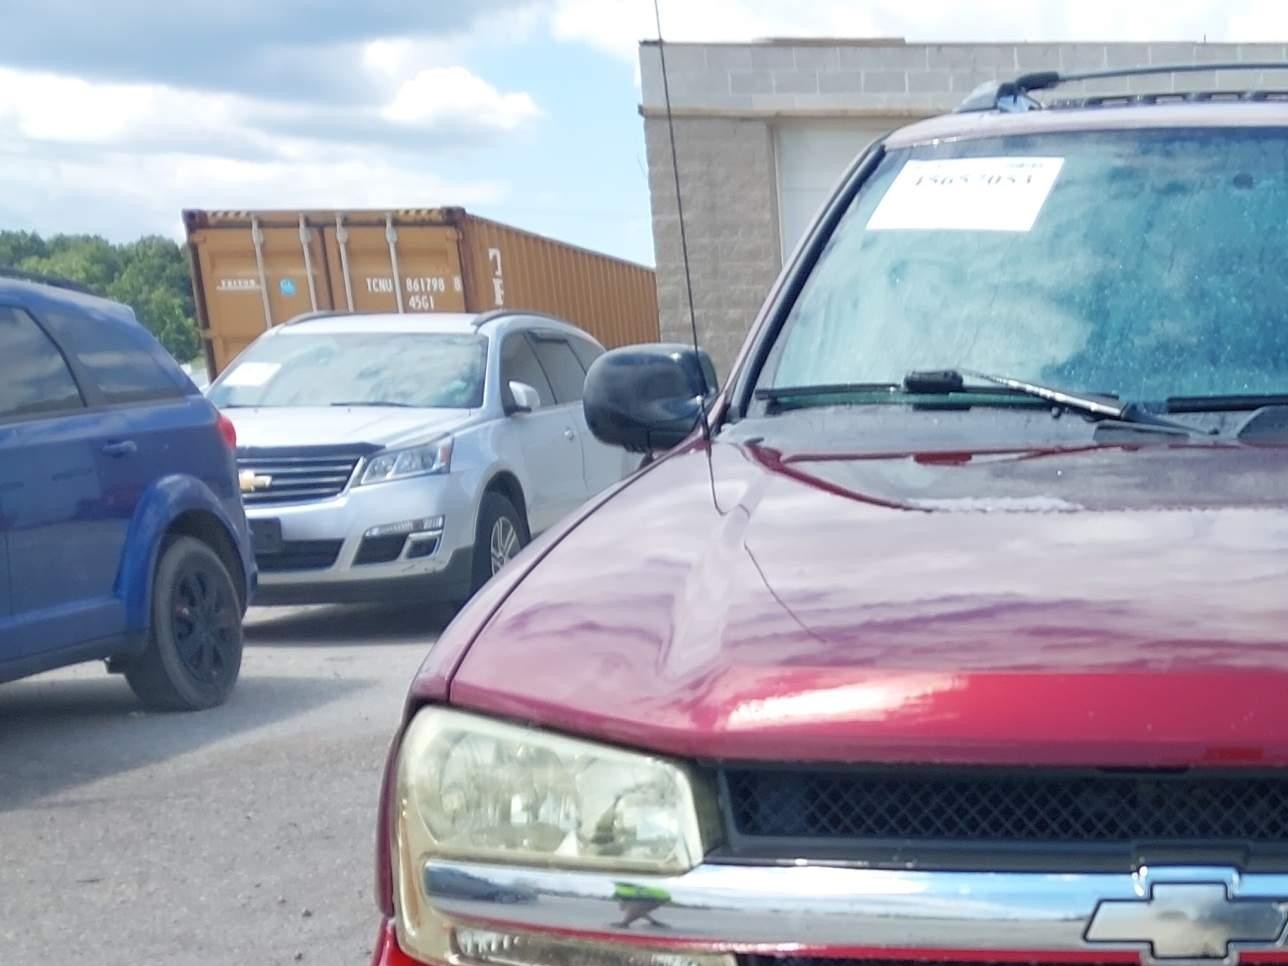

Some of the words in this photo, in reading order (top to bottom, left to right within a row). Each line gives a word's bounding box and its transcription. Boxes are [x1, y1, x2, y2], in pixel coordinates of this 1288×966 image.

[366, 277, 394, 292] TCNU
[406, 277, 445, 292] 861798
[409, 295, 434, 310] 45G1
